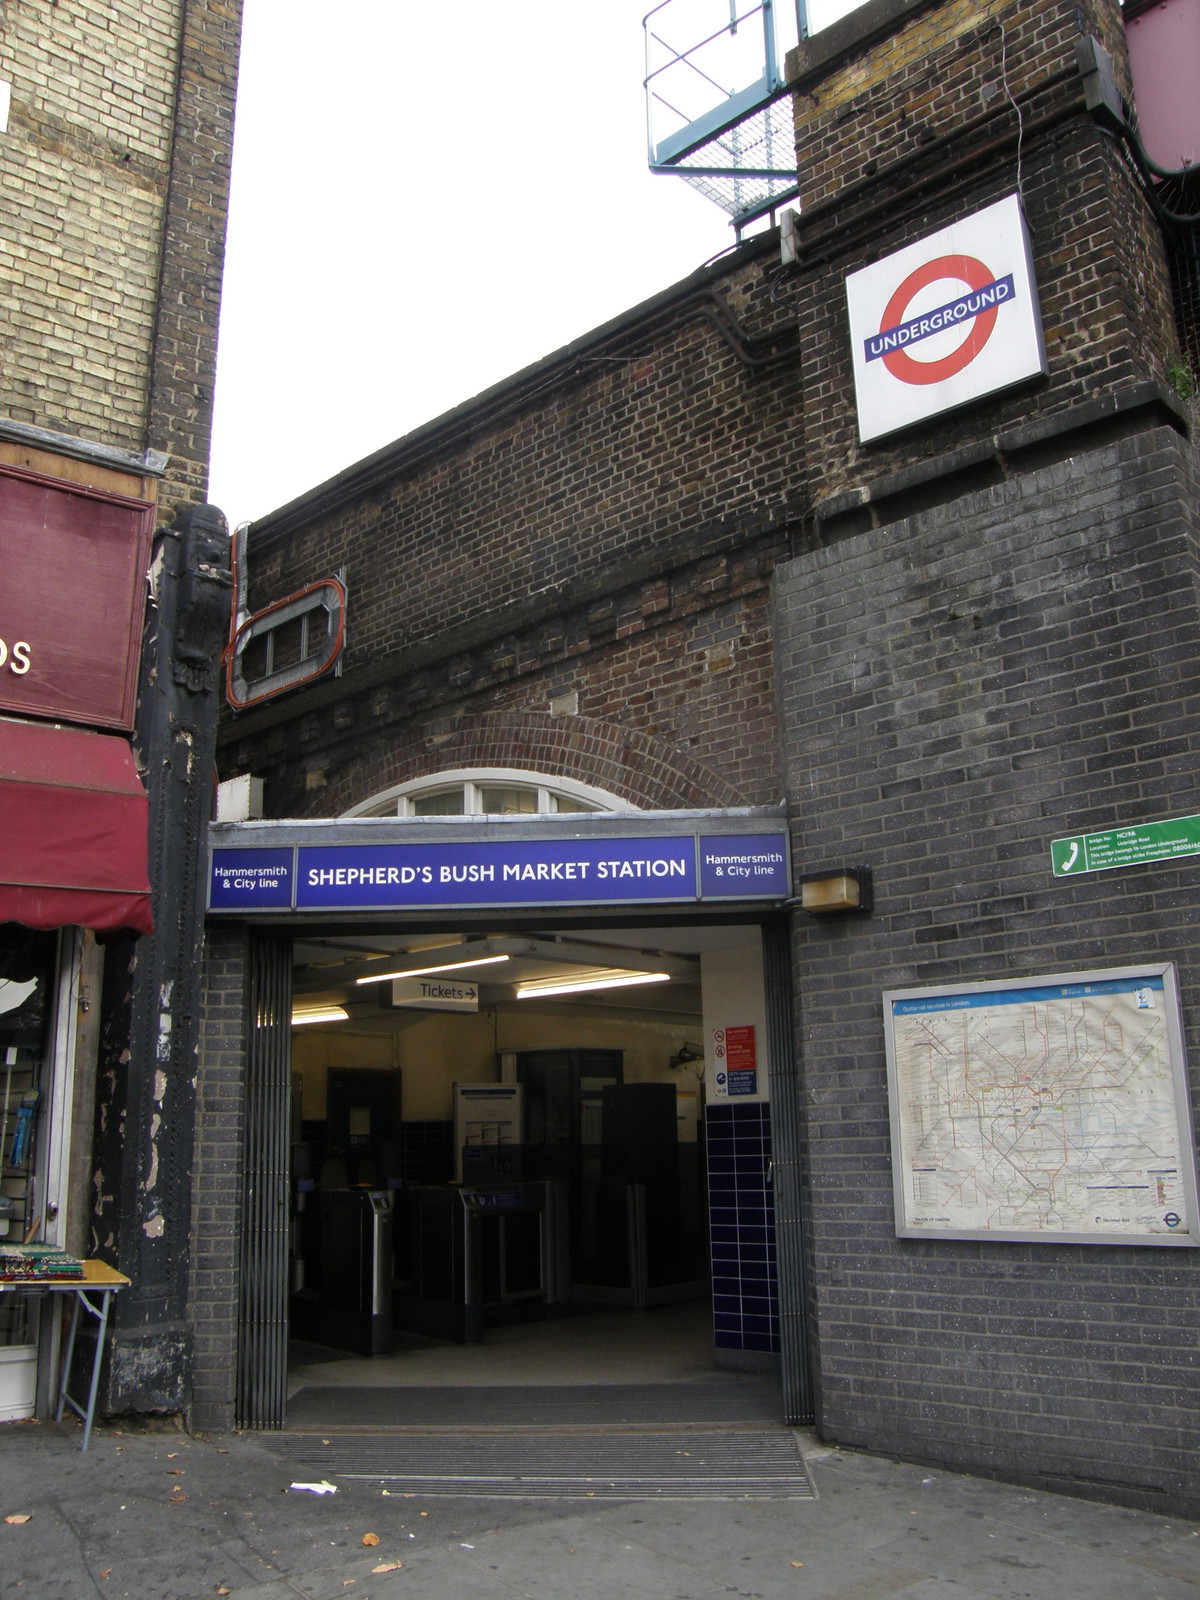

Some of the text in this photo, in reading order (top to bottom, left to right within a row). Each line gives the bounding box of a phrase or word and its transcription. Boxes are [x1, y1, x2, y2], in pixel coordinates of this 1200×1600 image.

[870, 283, 1009, 355] UNDERGROUND
[1114, 847, 1133, 855] belongs
[1157, 838, 1188, 847] Underground
[705, 853, 783, 865] Hammersmith
[214, 866, 288, 877] Hammersmith
[308, 859, 686, 886] SHEPHERD'S BUSH MARKET STATION
[715, 864, 774, 878] & City line
[222, 878, 279, 890] & City line
[420, 982, 464, 1000] Tickets
